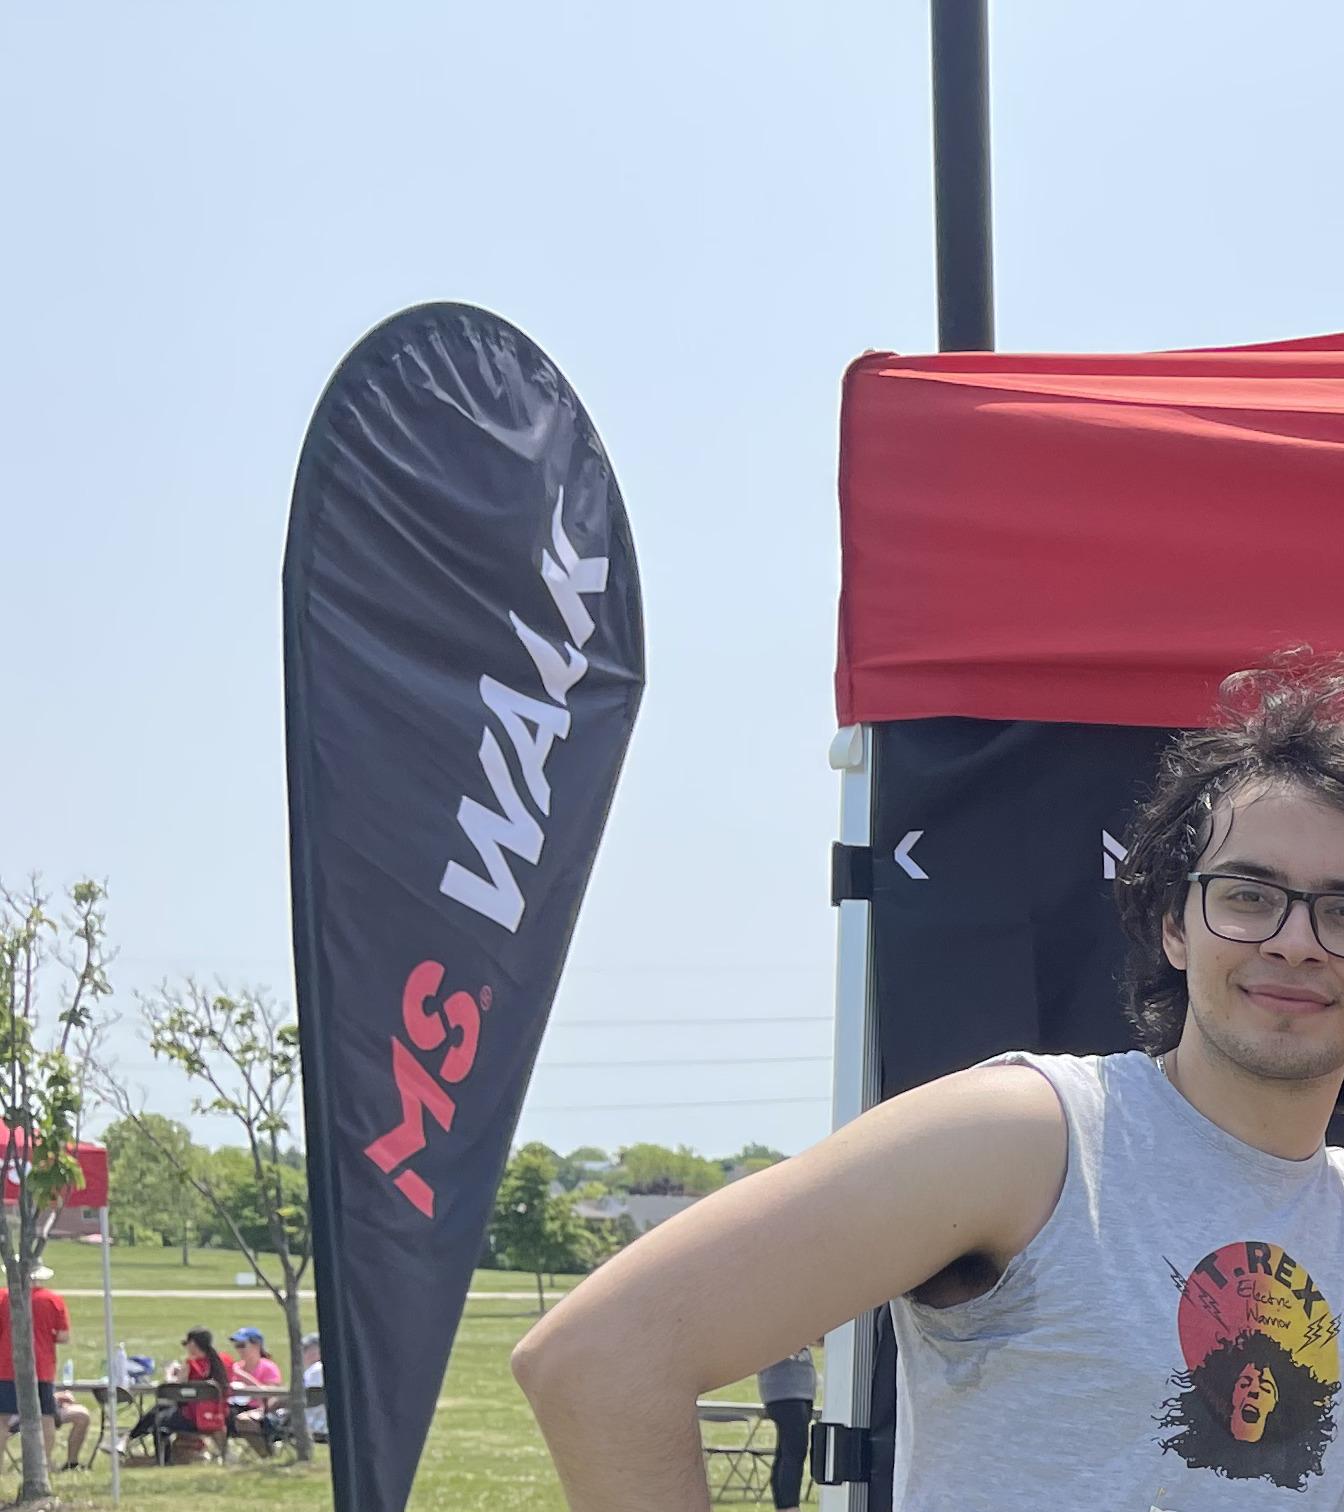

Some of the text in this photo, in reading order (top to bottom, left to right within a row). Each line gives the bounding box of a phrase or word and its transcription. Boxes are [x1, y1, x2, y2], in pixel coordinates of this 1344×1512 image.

[438, 484, 610, 934] WALK
[362, 958, 482, 1220] MS
[1193, 1241, 1326, 1320] T.REX
